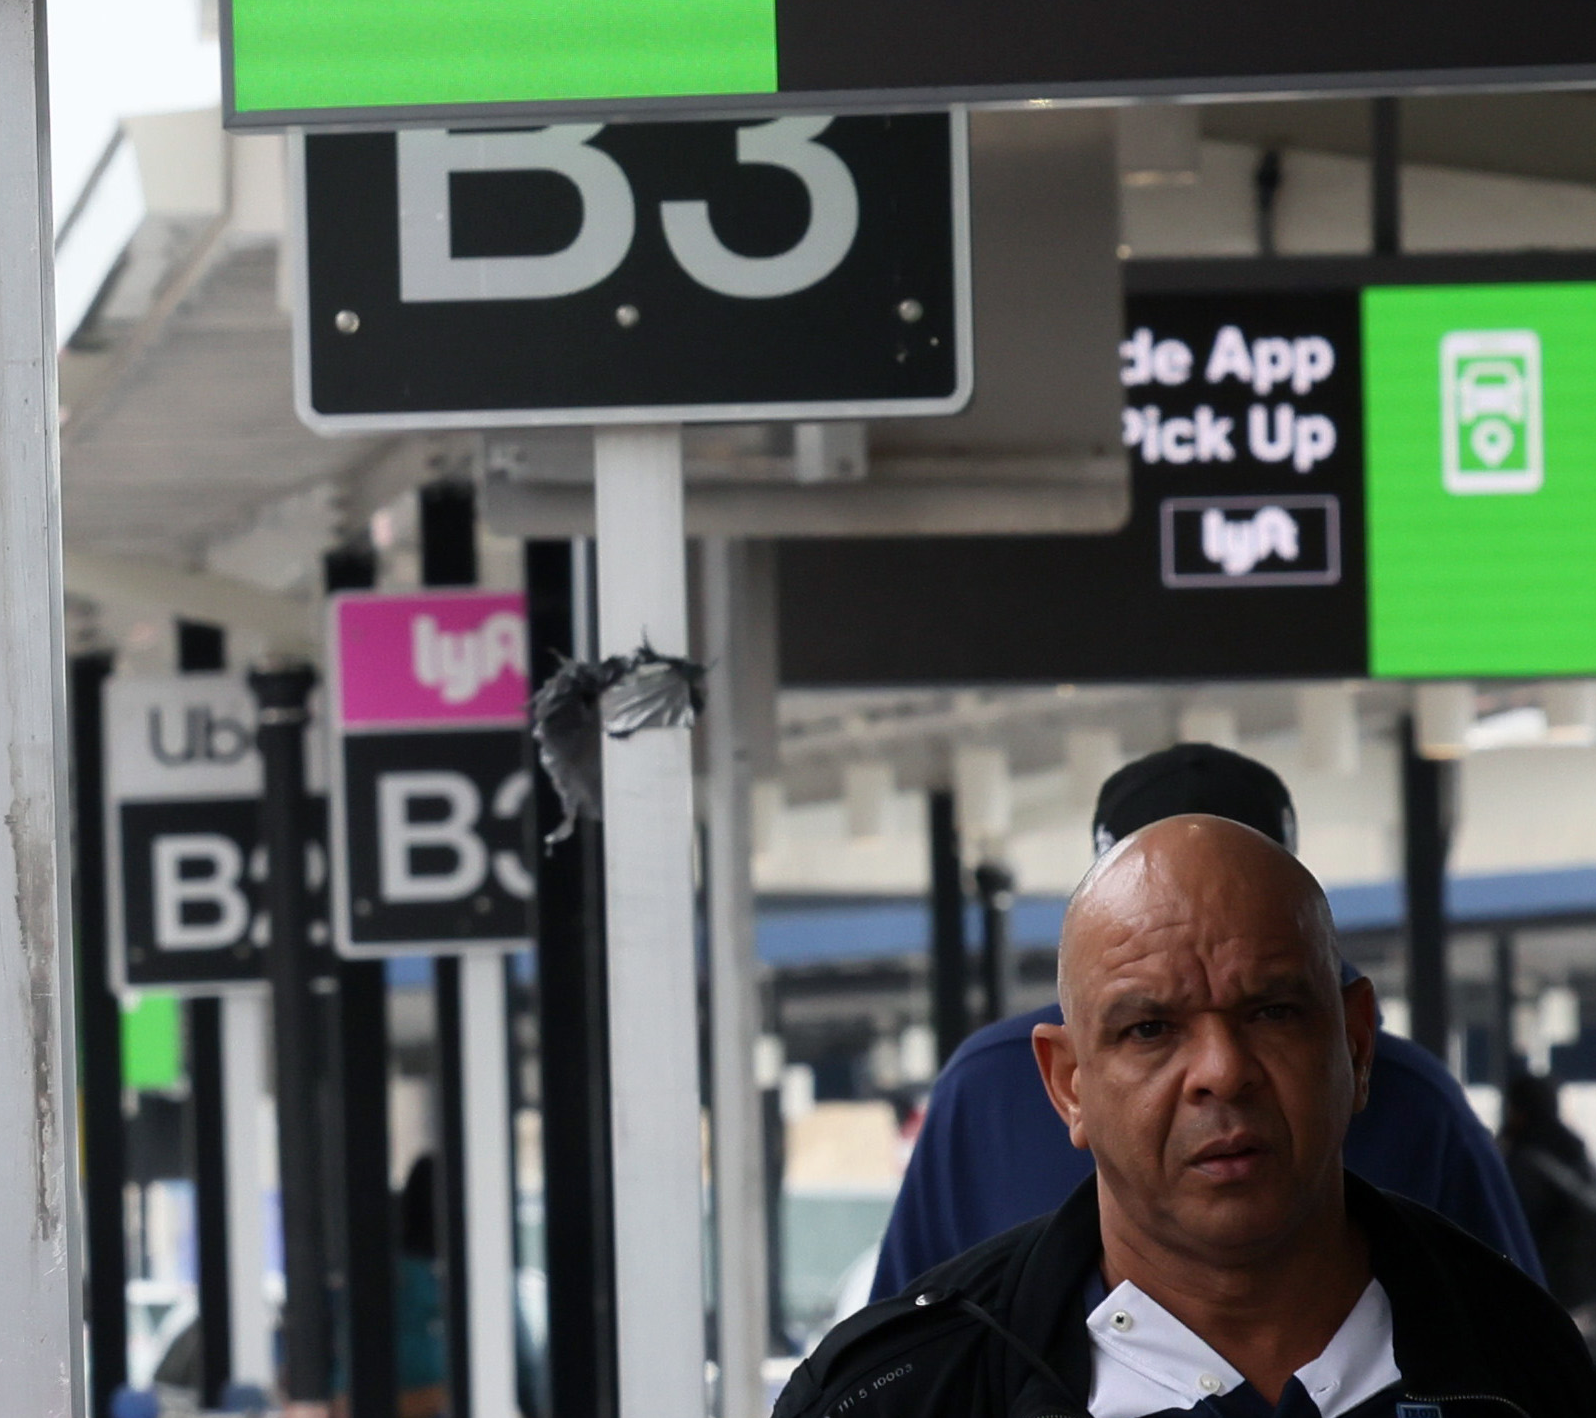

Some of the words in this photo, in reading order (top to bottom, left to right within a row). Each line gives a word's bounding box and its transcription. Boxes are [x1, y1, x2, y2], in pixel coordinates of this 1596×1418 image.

[395, 114, 860, 303] B3
[1205, 324, 1335, 395] App
[1247, 402, 1337, 473] Up
